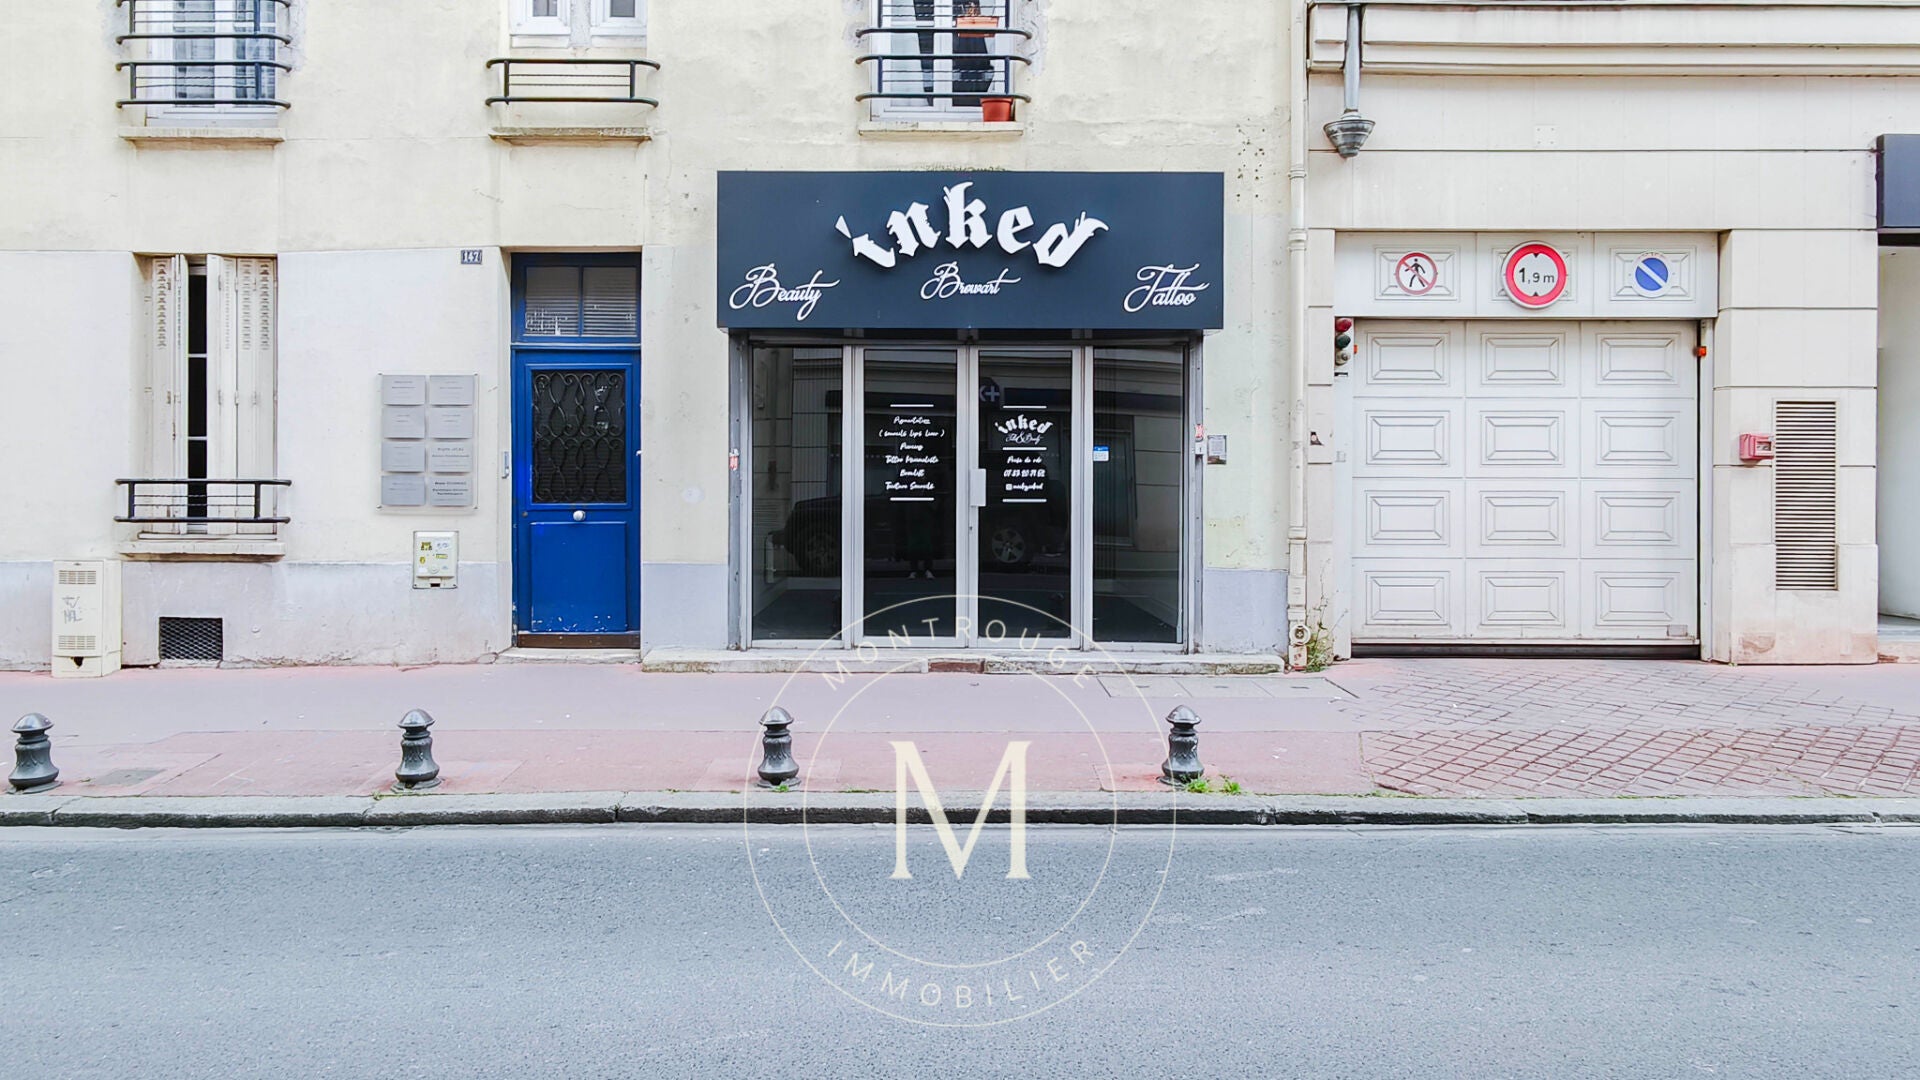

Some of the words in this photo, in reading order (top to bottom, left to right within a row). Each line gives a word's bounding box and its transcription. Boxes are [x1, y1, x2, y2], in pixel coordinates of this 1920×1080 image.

[835, 181, 1109, 267] inked
[729, 261, 840, 321] Beauty
[920, 261, 1021, 299] Browart
[1123, 262, 1210, 312] Tattoo
[994, 414, 1053, 434] inked
